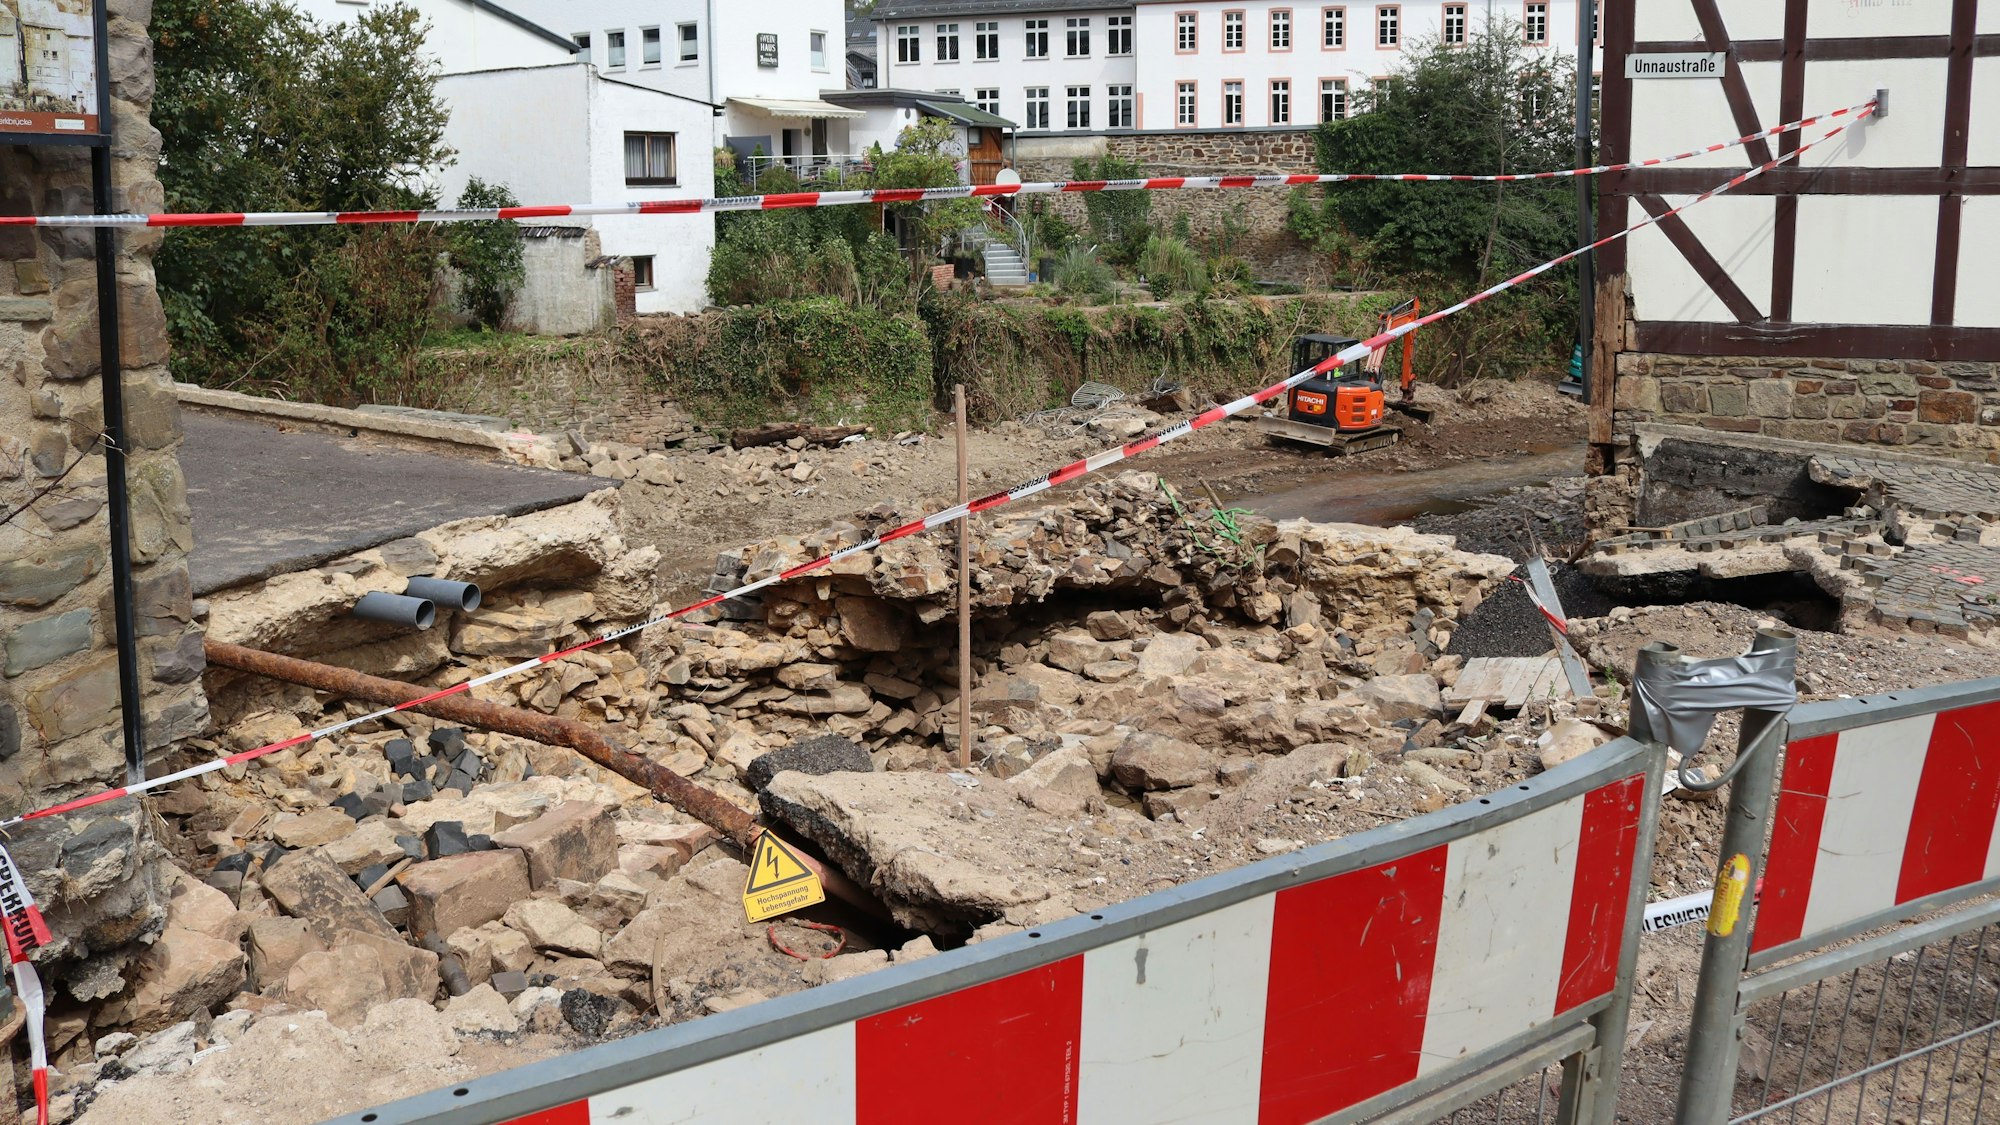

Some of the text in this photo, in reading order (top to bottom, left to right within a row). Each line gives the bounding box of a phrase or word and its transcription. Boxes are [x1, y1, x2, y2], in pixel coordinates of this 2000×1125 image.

[760, 43, 776, 52] HAUS
[1635, 58, 1715, 73] Unnaustraße
[1297, 395, 1325, 405] HITACHI
[757, 885, 809, 905] Hochspannung
[762, 894, 809, 913] Lebensgefahr
